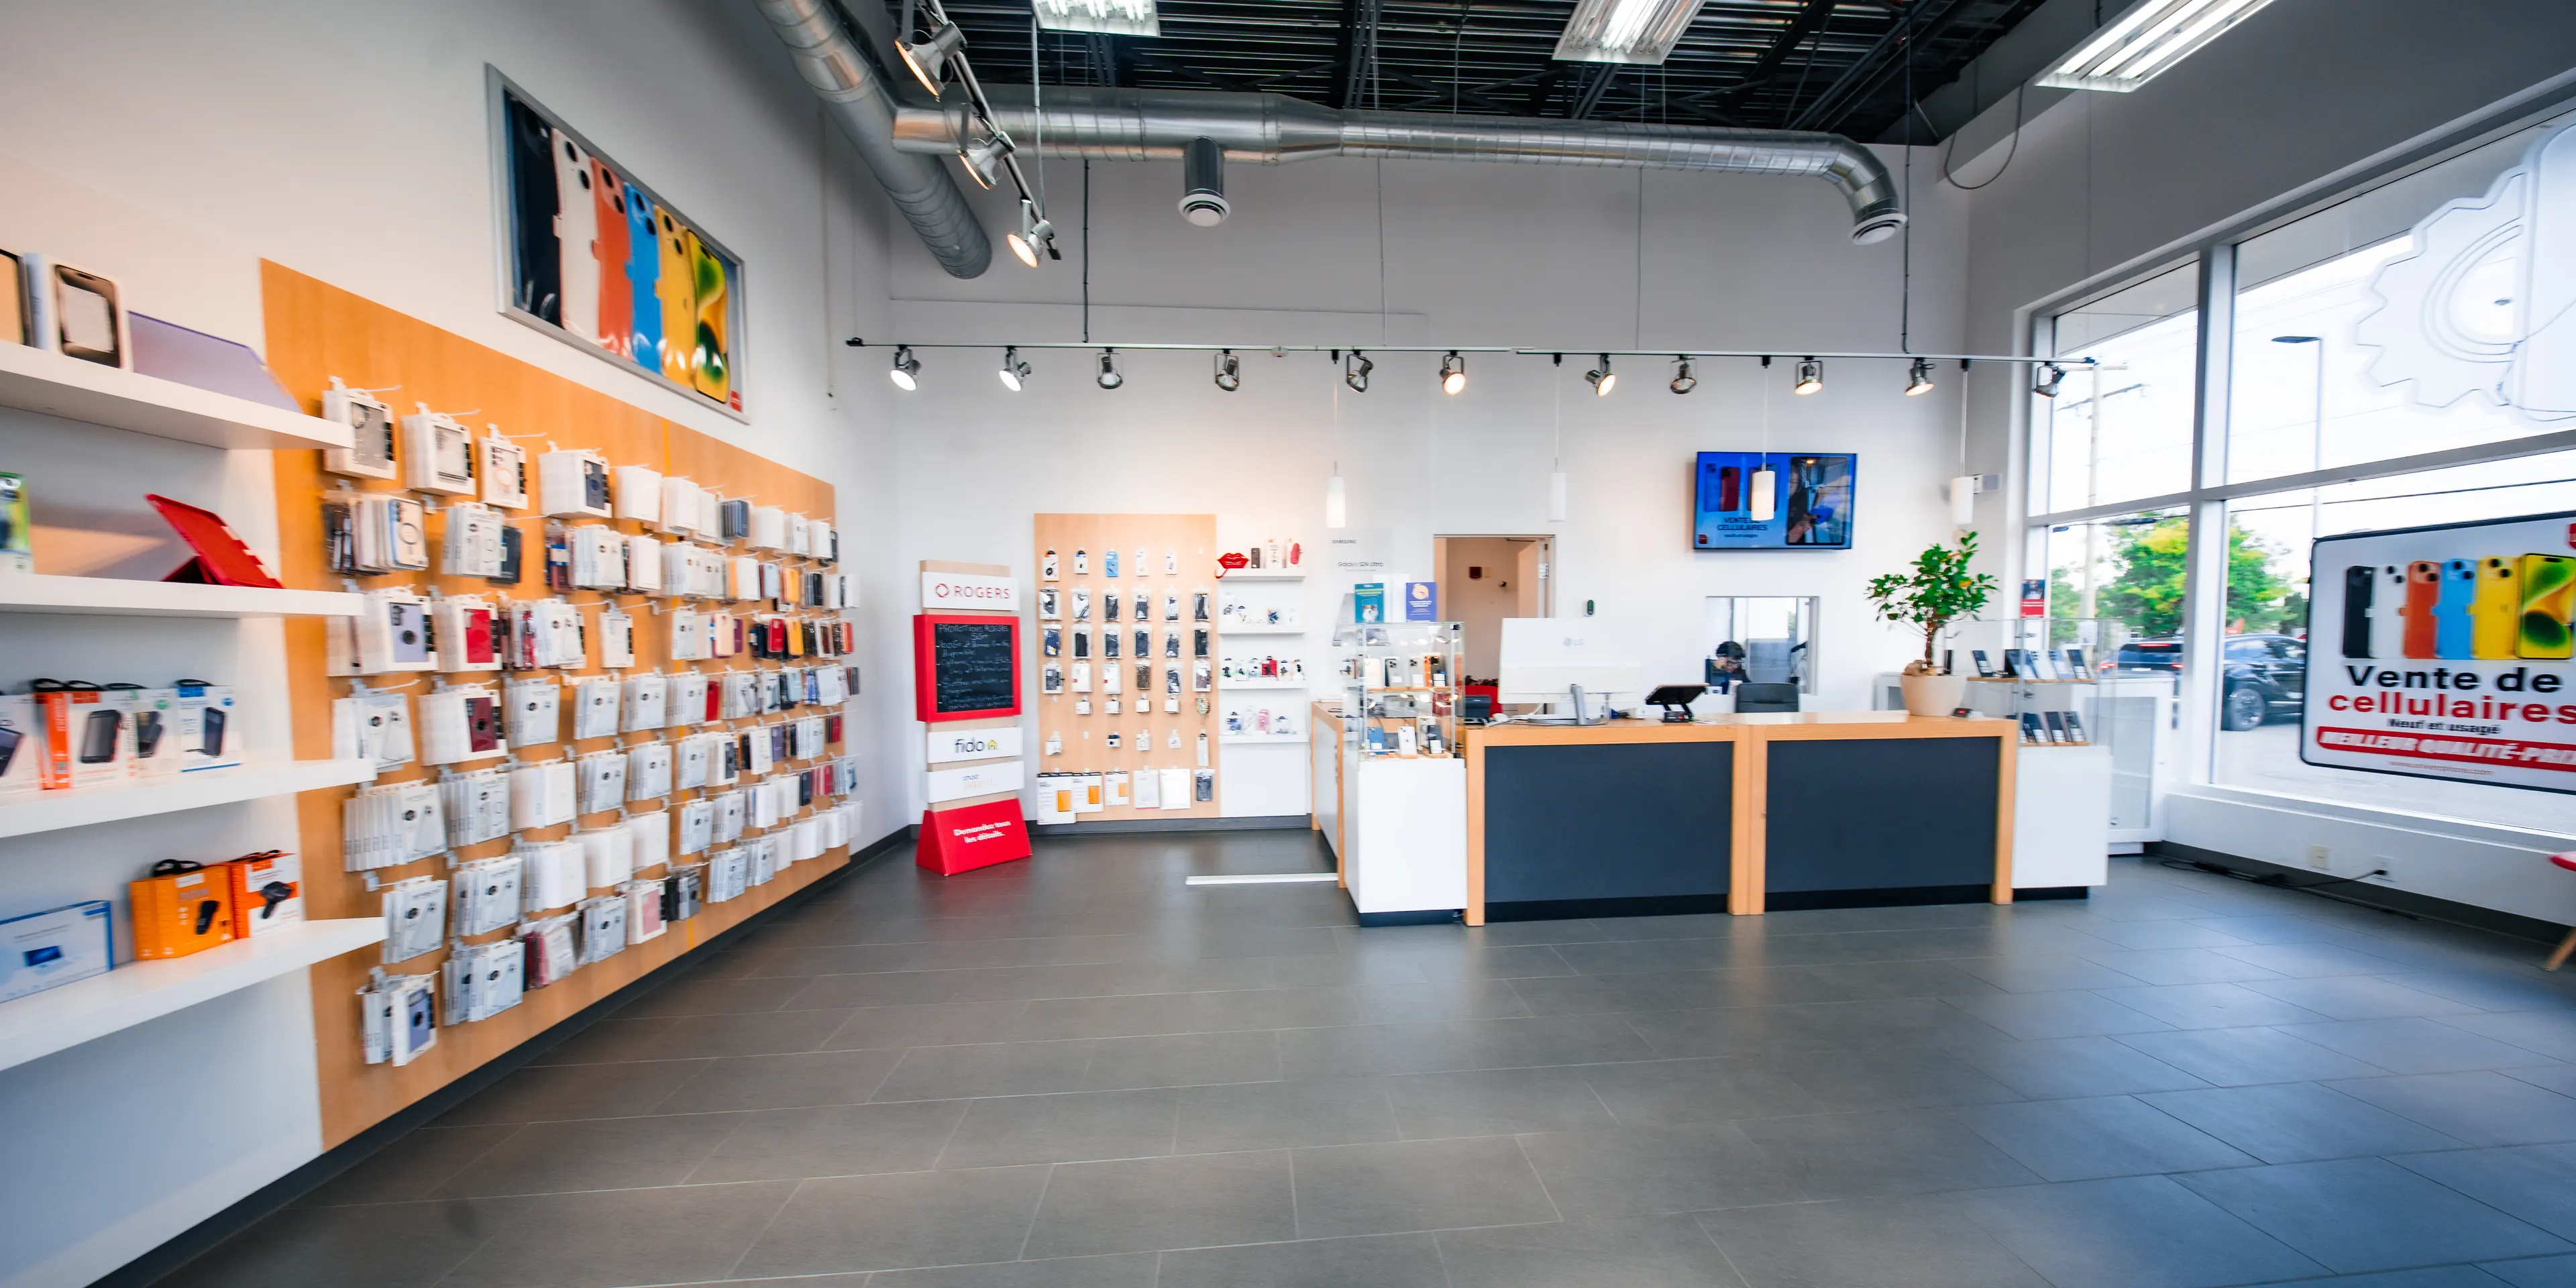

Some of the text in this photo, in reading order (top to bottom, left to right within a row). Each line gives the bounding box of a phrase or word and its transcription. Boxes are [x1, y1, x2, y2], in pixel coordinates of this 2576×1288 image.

[954, 586, 1010, 599] ROGERS
[2345, 665, 2562, 693] Vente de
[2329, 692, 2576, 724] cellulaires
[2387, 718, 2503, 736] Neuf et usagé
[955, 738, 985, 753] fido
[2321, 731, 2419, 752] MEILLEUR
[953, 824, 995, 836] Demandez
